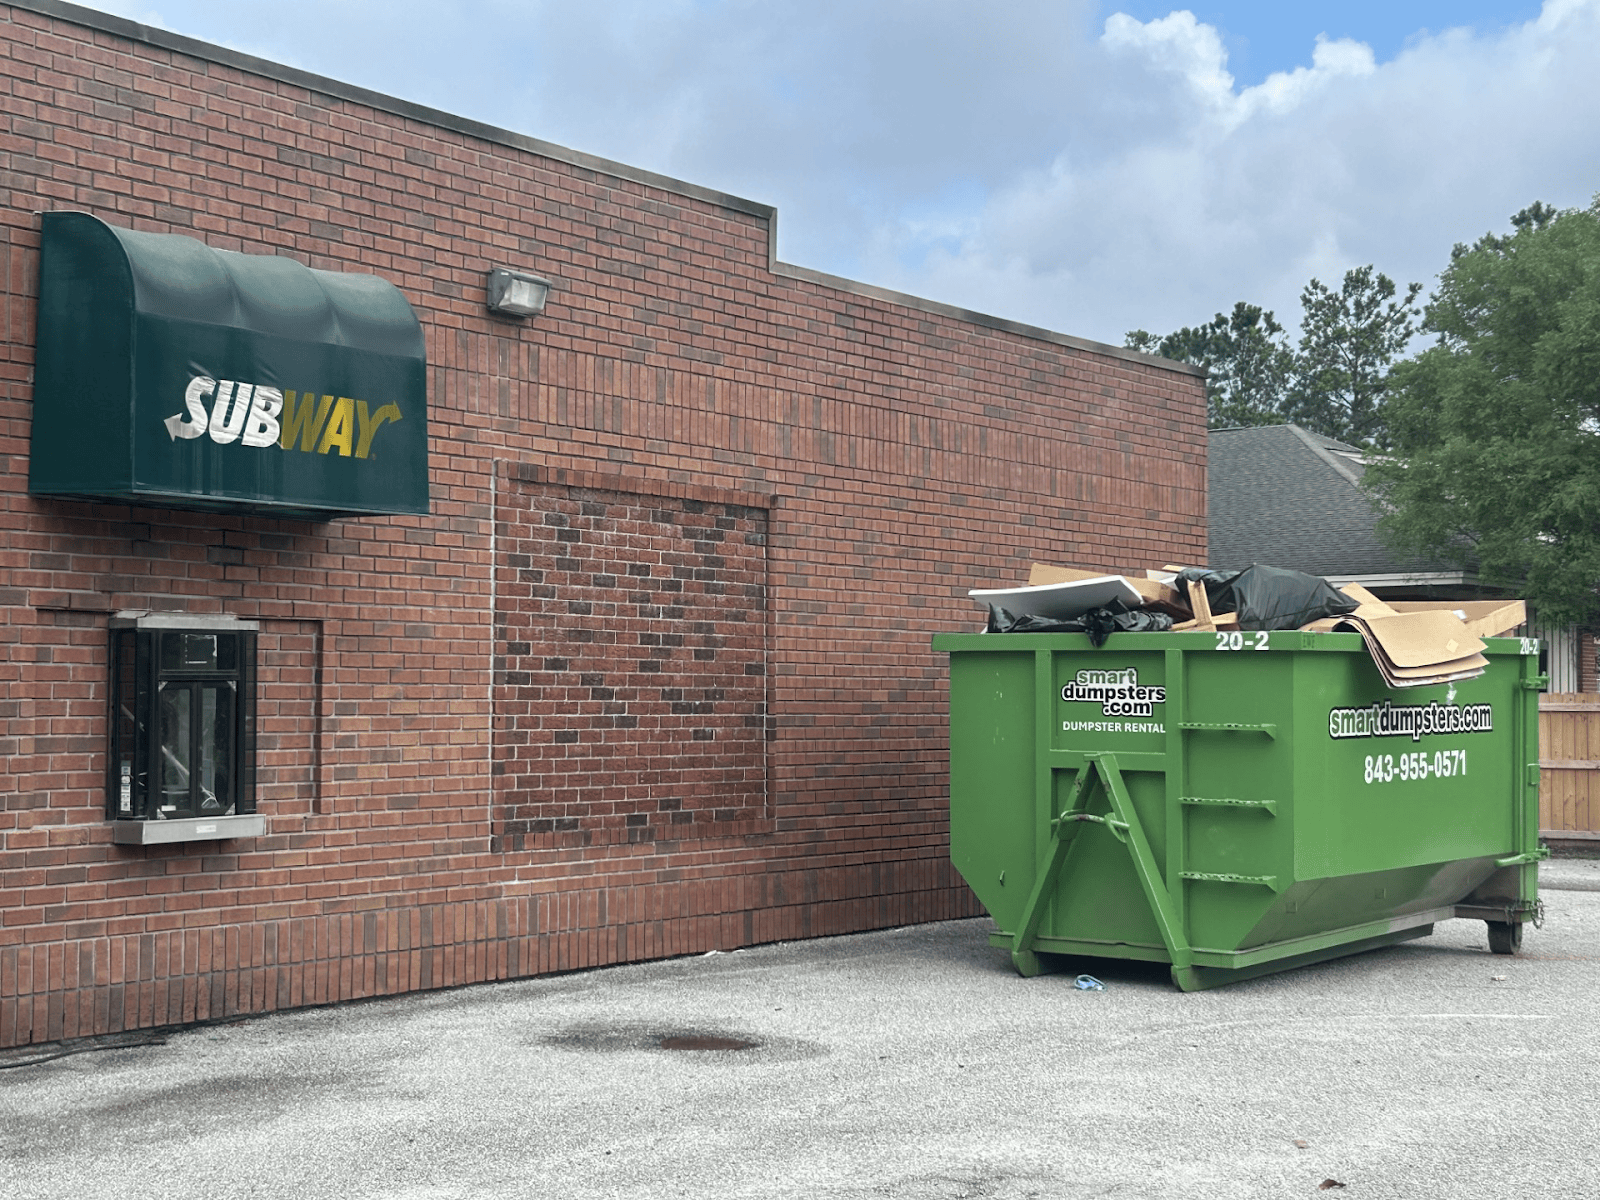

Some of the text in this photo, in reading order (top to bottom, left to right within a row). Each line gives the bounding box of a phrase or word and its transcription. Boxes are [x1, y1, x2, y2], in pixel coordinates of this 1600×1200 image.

[164, 376, 402, 459] SUBWAY
[1215, 630, 1269, 651] 20-2
[1520, 638, 1538, 655] 20-2
[1076, 668, 1136, 685] smart
[1062, 683, 1166, 702] dumpsters
[1103, 701, 1152, 715] .com
[1062, 720, 1166, 733] DUMPSTER RENTAL
[1330, 701, 1492, 740] smartdumpsters.com
[1364, 749, 1466, 784] 843-955-0571
